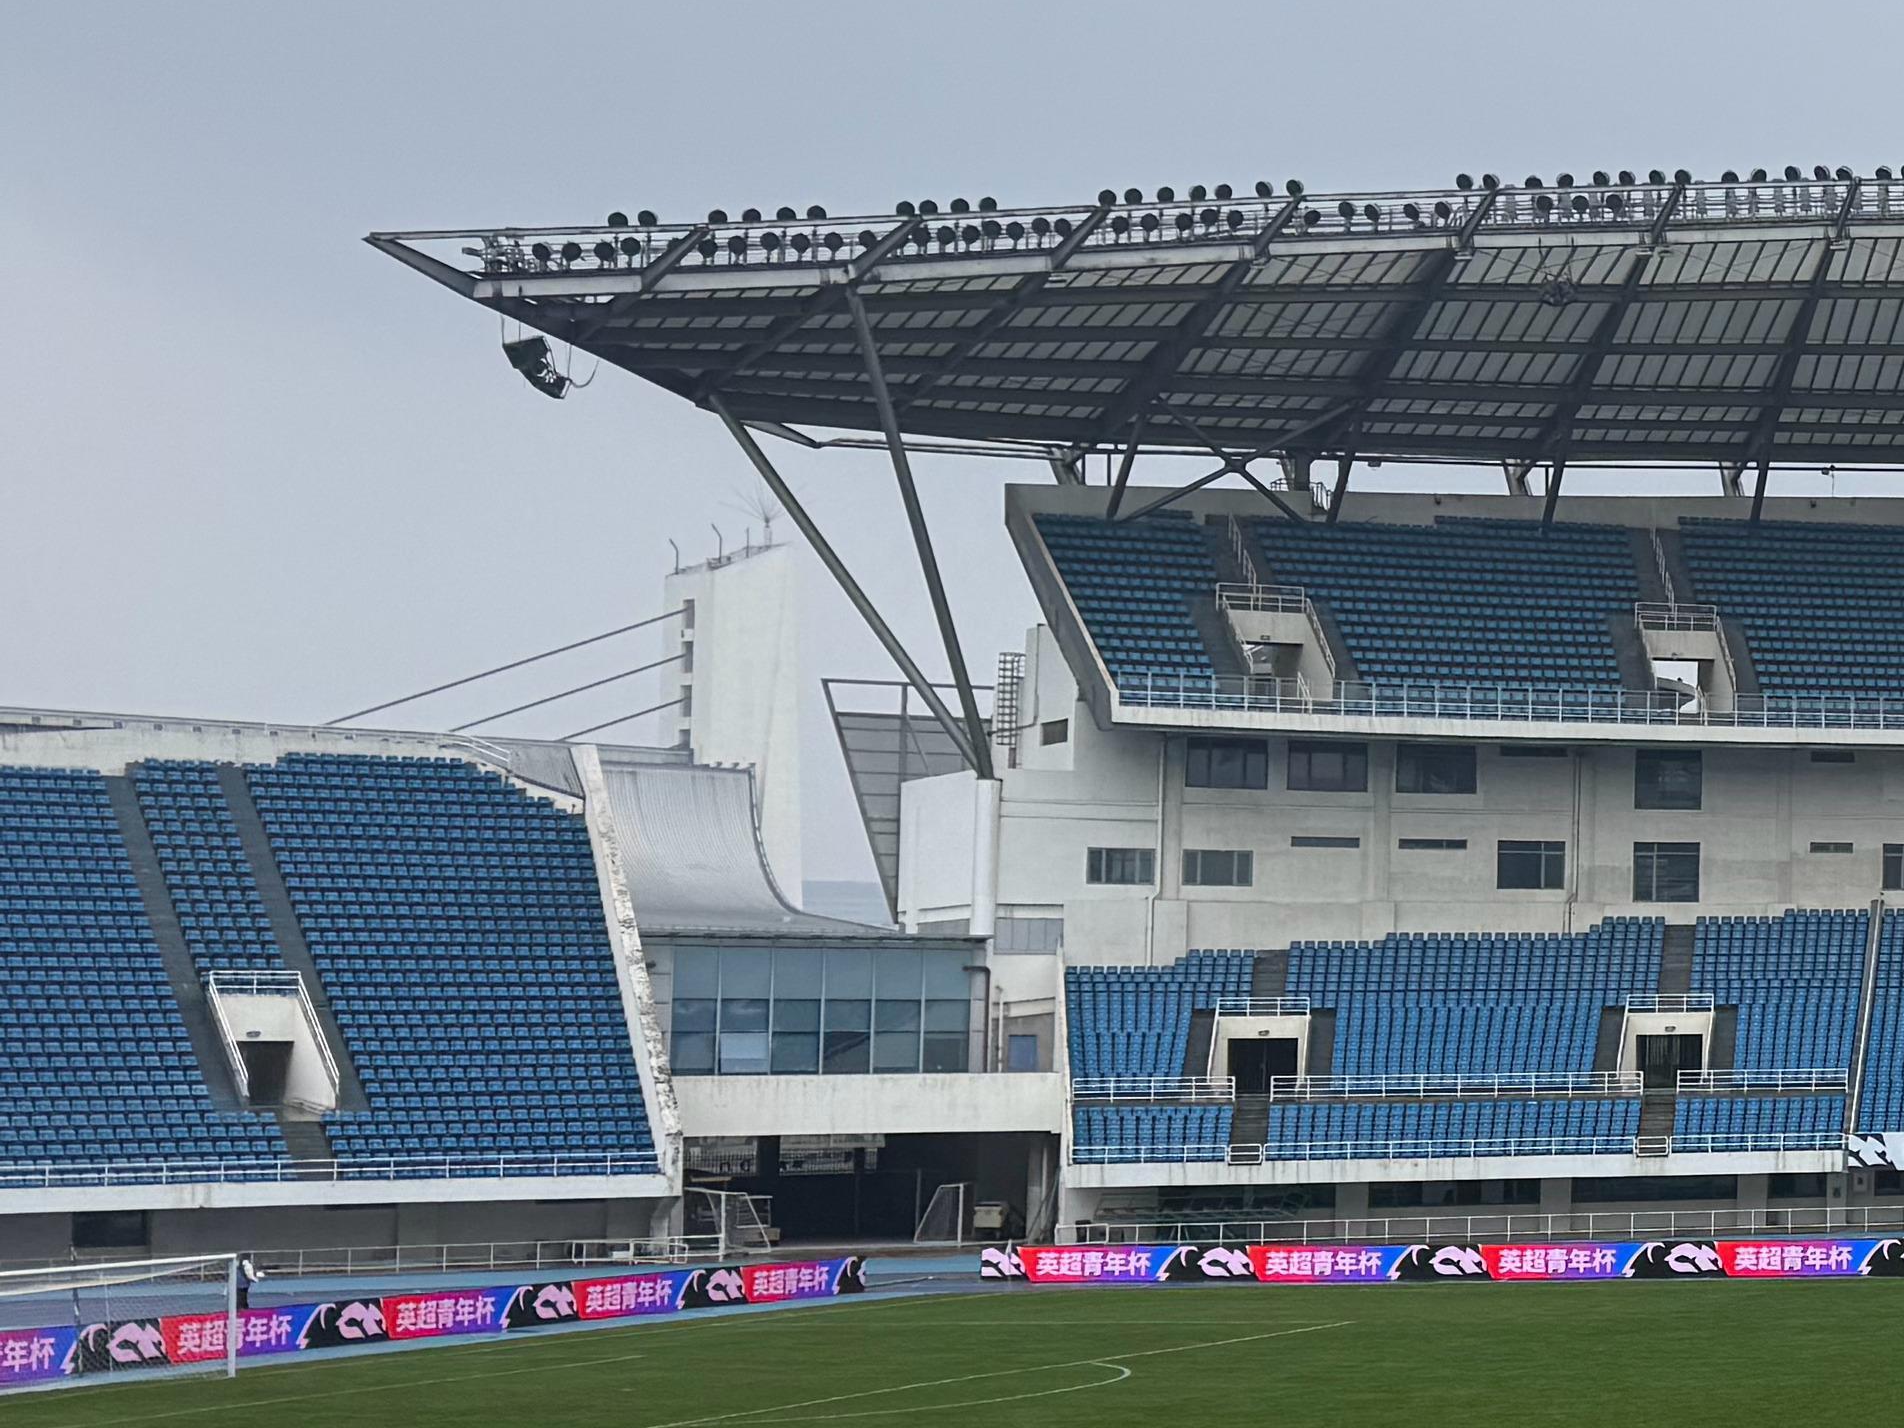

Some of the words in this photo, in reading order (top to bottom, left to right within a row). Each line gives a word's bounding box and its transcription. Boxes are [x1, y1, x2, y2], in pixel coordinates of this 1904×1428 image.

[1036, 1251, 1150, 1276] 英超青年杯
[1265, 1250, 1382, 1276] 英超青年杯
[1498, 1248, 1617, 1273] 英超青年杯
[1734, 1245, 1854, 1271] 英超青年杯
[752, 1265, 829, 1296] 英超青年杯
[584, 1278, 673, 1312] 英超青年杯
[396, 1295, 496, 1331] 英超青年杯
